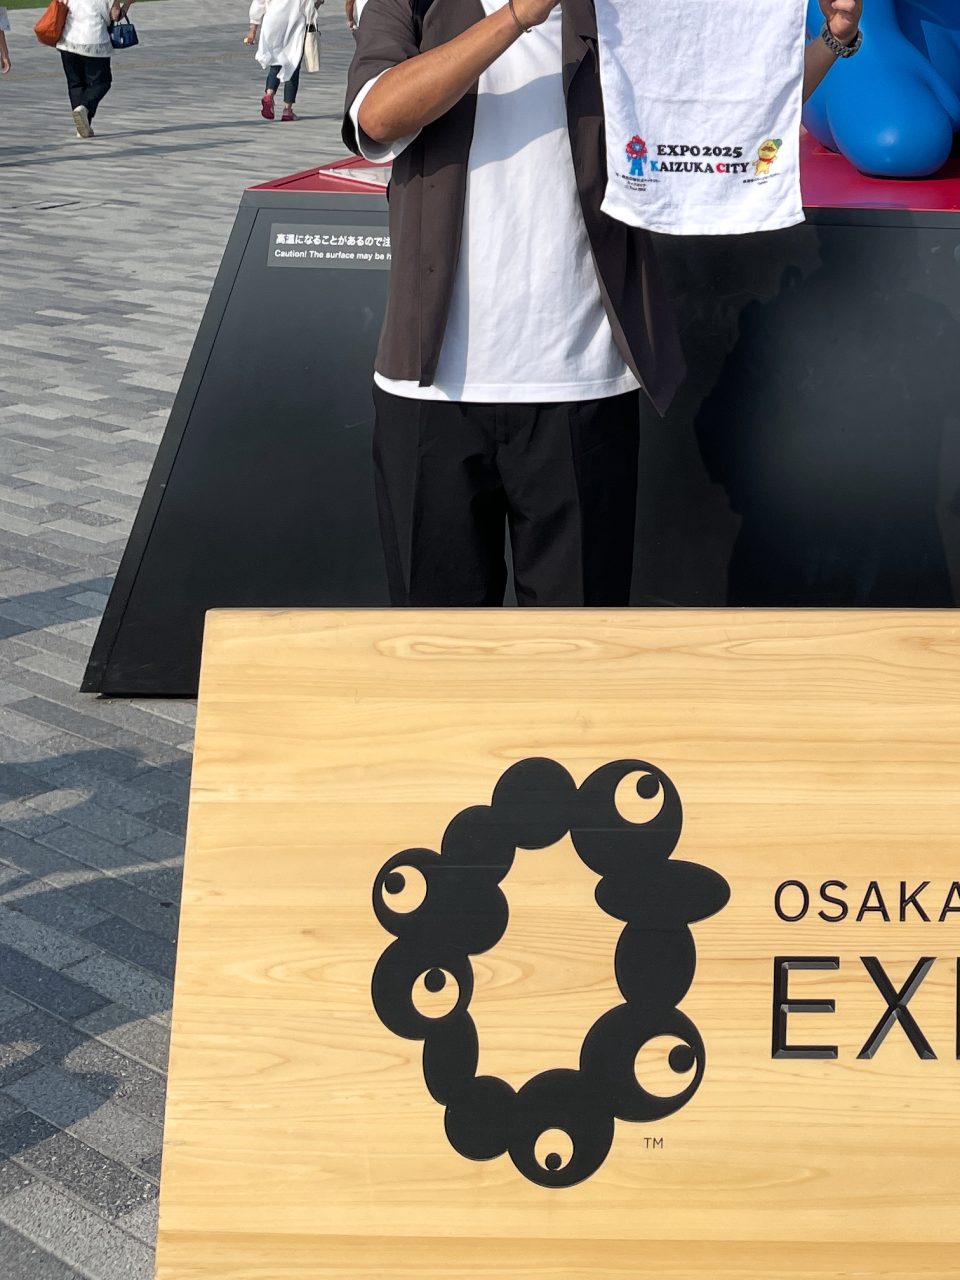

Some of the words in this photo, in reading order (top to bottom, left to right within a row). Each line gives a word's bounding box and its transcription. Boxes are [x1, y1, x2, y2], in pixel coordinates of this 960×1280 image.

[657, 145, 700, 156] EXPO
[702, 146, 743, 158] 2025
[650, 160, 714, 173] KAIZUKA
[715, 162, 749, 173] CITY
[274, 249, 307, 258] Caution!
[309, 250, 324, 258] The
[325, 251, 355, 259] surface
[356, 253, 373, 261] may
[374, 252, 385, 260] be
[643, 1137, 664, 1149] TM
